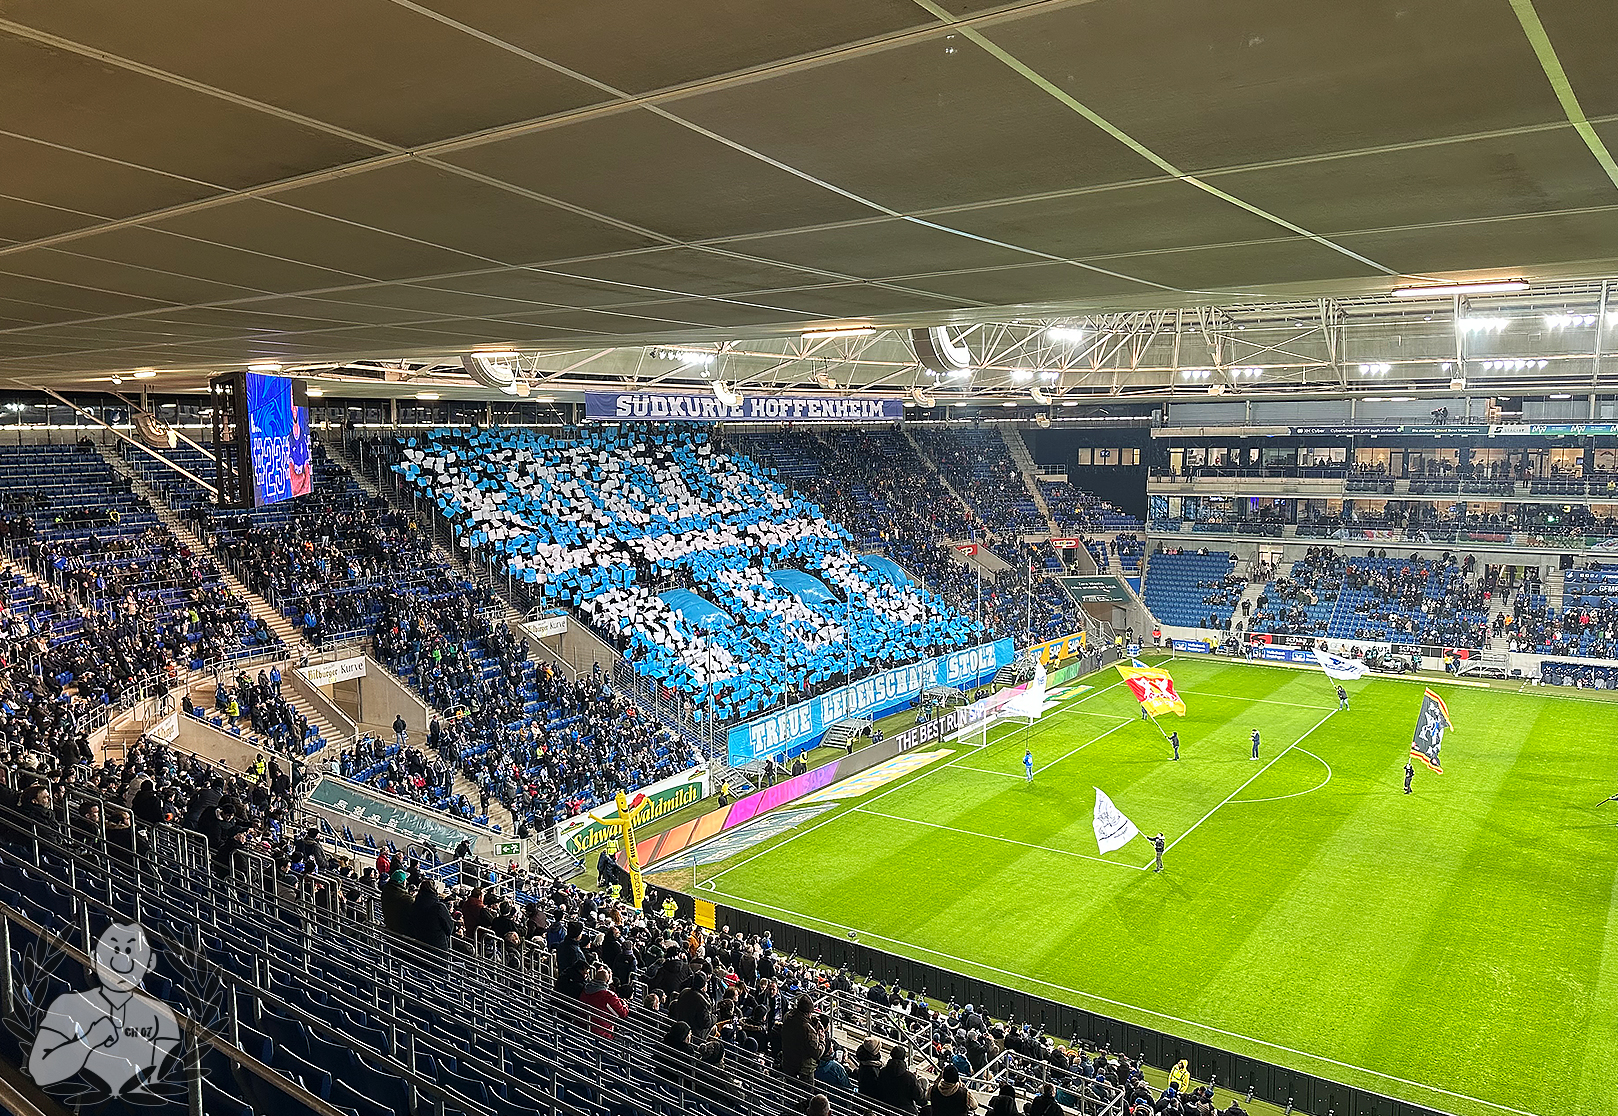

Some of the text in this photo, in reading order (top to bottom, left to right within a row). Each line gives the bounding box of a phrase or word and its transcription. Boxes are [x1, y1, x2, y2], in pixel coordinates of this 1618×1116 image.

[616, 394, 885, 418] SÜDKURVE HOFFENHEIM
[1049, 644, 1061, 658] SAP
[1068, 638, 1080, 652] SAP
[307, 668, 338, 681] Bitburger
[340, 661, 363, 674] Kurve
[751, 645, 996, 753] TREUE LEIDENSCHAFT STOLZ
[896, 728, 918, 753] THE
[920, 717, 946, 744] BEST
[946, 708, 968, 732] RUN
